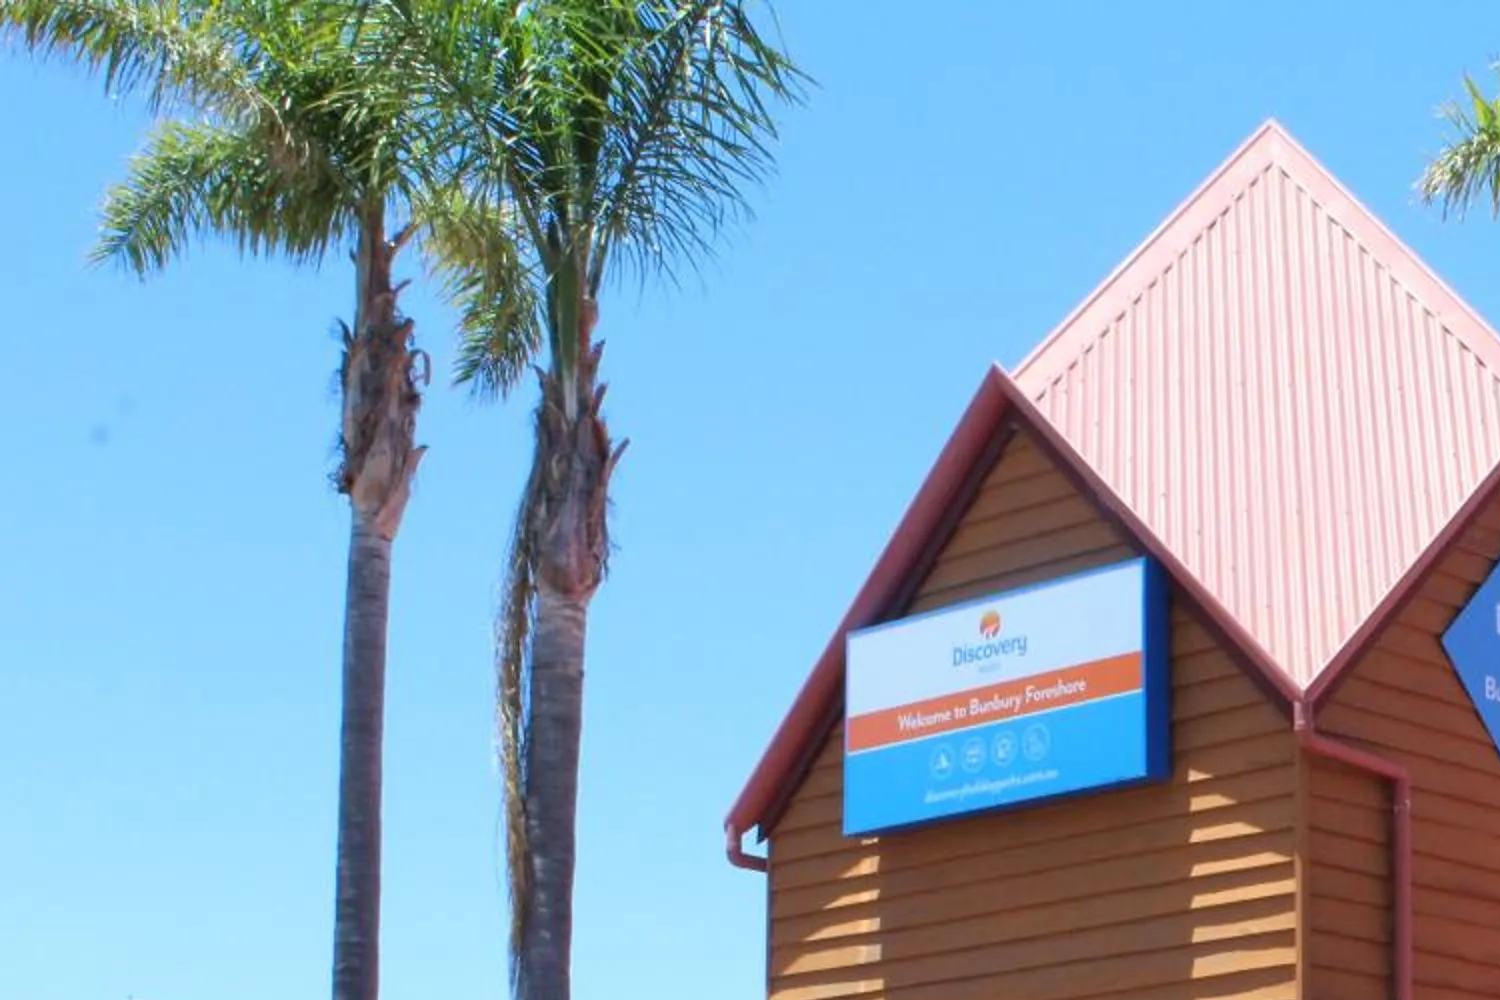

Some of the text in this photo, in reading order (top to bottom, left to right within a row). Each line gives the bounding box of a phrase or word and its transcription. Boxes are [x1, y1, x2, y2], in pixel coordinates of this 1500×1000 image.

[953, 636, 1027, 666] Discovery
[898, 680, 1086, 729] Welcome to Bunbury Foreshore
